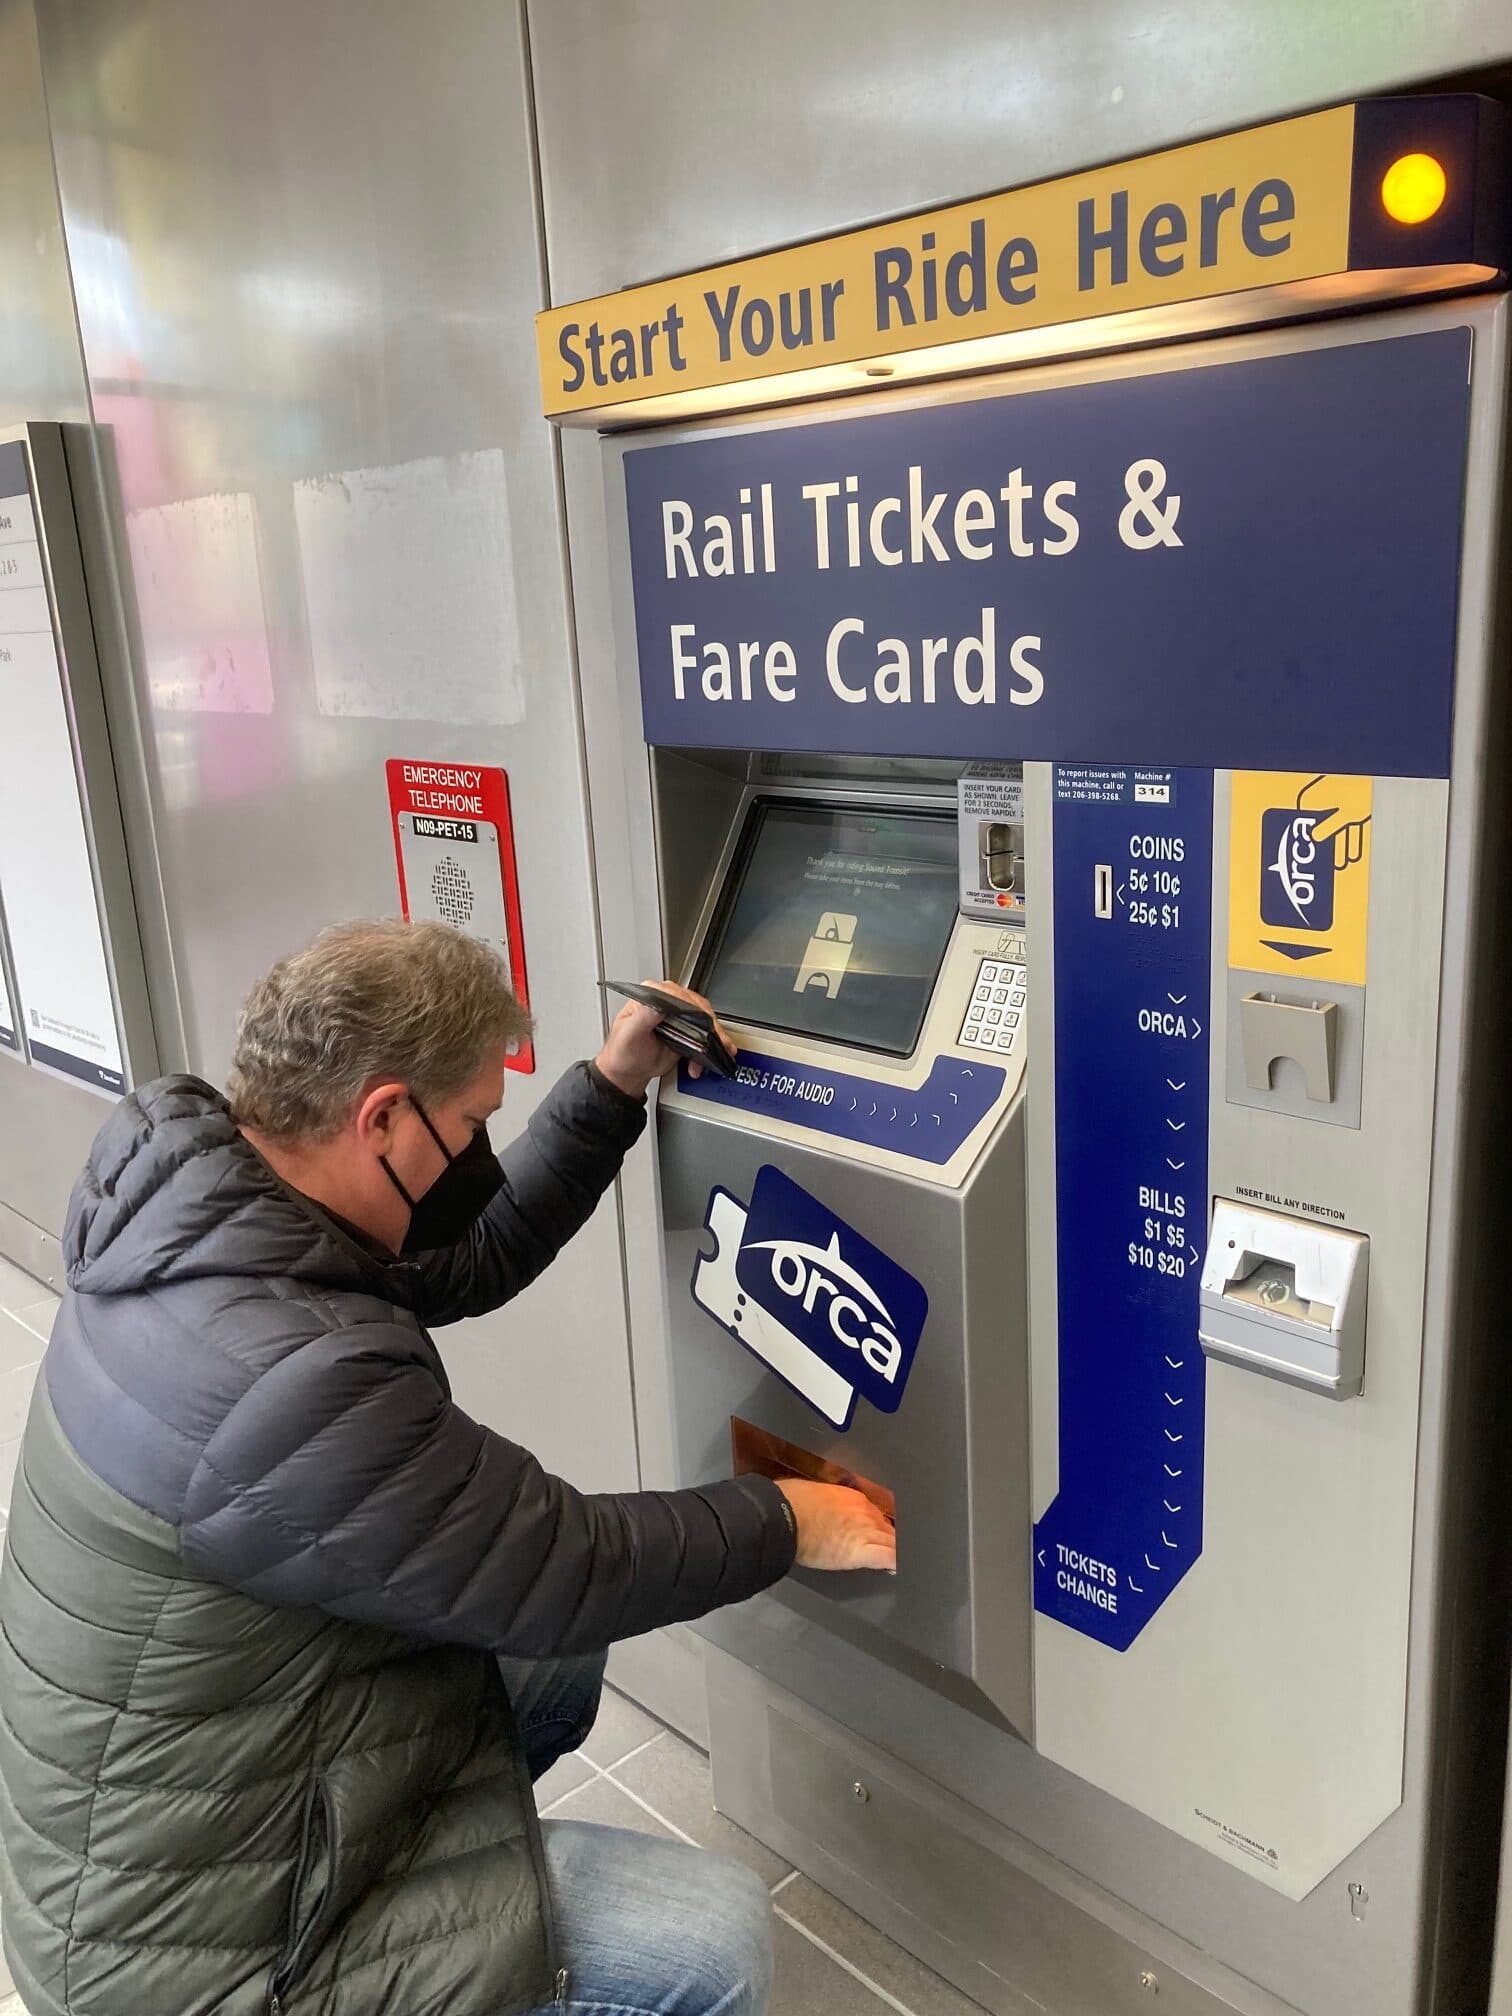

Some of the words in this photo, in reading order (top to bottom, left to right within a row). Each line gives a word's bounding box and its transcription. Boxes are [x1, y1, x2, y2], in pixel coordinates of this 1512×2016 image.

[558, 303, 686, 393] Start
[704, 273, 844, 362] Your
[875, 220, 1037, 332] Ride
[1077, 178, 1296, 292] Here
[662, 483, 776, 579] Rail
[802, 466, 1079, 569] Tickets
[1118, 458, 1184, 551] &
[670, 624, 797, 702] Fare
[825, 607, 1044, 706] Cards
[403, 765, 482, 789] EMERGENCY
[1058, 768, 1066, 776] To
[1067, 770, 1088, 779] report
[1089, 770, 1109, 779] issues
[1111, 771, 1127, 780] with
[1058, 779, 1070, 788] this
[1103, 781, 1115, 789] call
[1134, 772, 1163, 781] Machine
[408, 789, 484, 814] TELEPHONE
[986, 785, 1003, 793] YOUR
[1004, 786, 1022, 794] CARD
[1058, 790, 1071, 798] text
[1138, 787, 1166, 796] 314
[415, 818, 475, 840] N09-PET-15
[1129, 835, 1185, 862] COINS
[1291, 817, 1317, 906] orca
[1129, 868, 1149, 894] 5¢
[1153, 870, 1181, 898] 10¢
[1129, 901, 1158, 928] 25¢
[1161, 903, 1179, 929] $1
[1138, 1009, 1187, 1038] ORCA
[734, 1065, 761, 1086] ESS
[760, 1072, 770, 1089] 5
[770, 1074, 796, 1097] FOR
[795, 1082, 836, 1106] AUDIO
[1139, 1186, 1185, 1218] BILLS
[1236, 1186, 1263, 1201] INSERT
[1265, 1193, 1282, 1206] BILL
[1283, 1196, 1300, 1210] ANY
[1302, 1201, 1345, 1221] DIRECTION
[1144, 1218, 1161, 1242] $1
[1166, 1224, 1185, 1249] $5
[1128, 1242, 1154, 1269] $10
[1157, 1252, 1185, 1278] $20
[771, 1246, 902, 1384] orca
[1056, 1543, 1117, 1587] TICKETS
[1056, 1570, 1118, 1615] CHANGE
